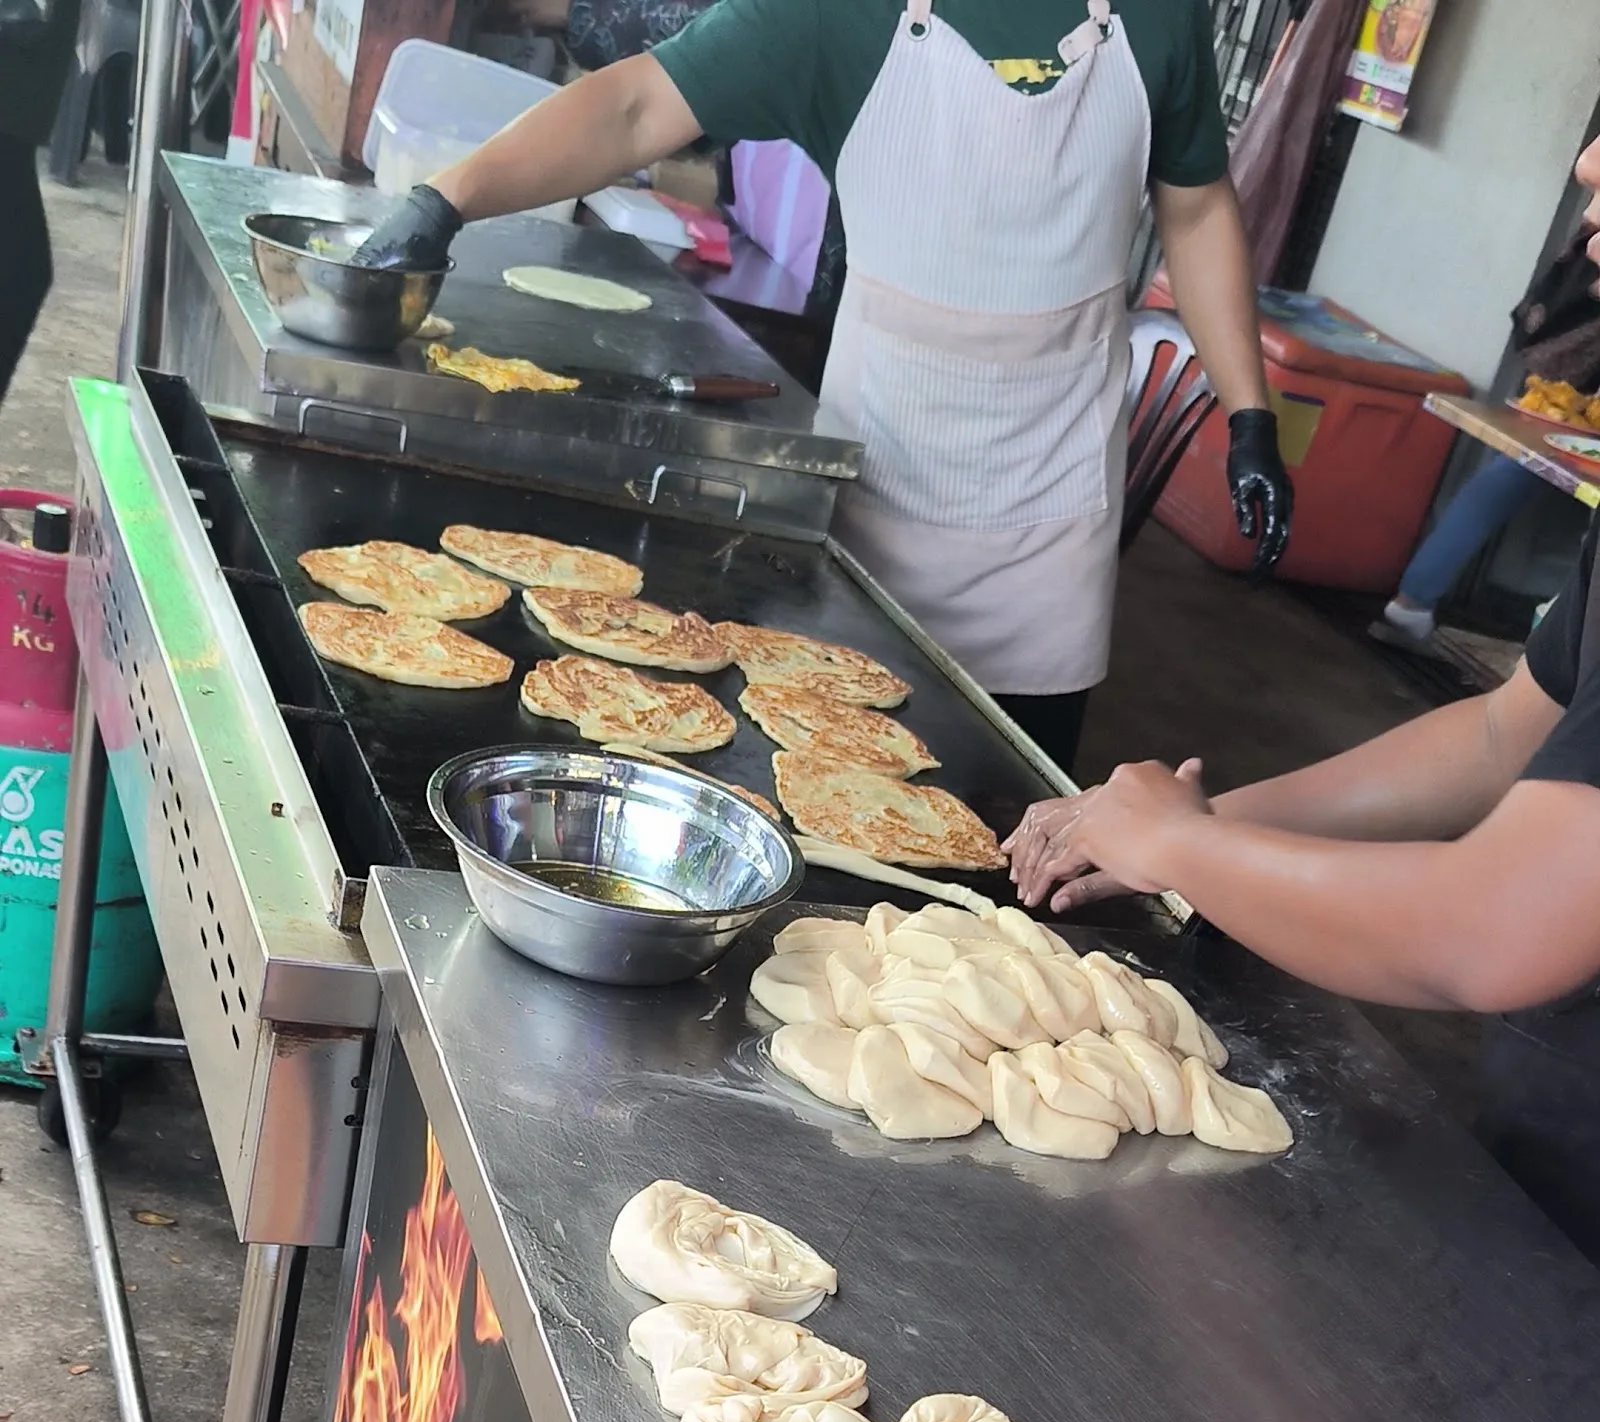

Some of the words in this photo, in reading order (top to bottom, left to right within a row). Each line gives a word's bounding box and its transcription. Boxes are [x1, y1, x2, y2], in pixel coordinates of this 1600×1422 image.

[17, 591, 56, 626] 14
[13, 624, 54, 652] KG
[0, 826, 65, 860] AS
